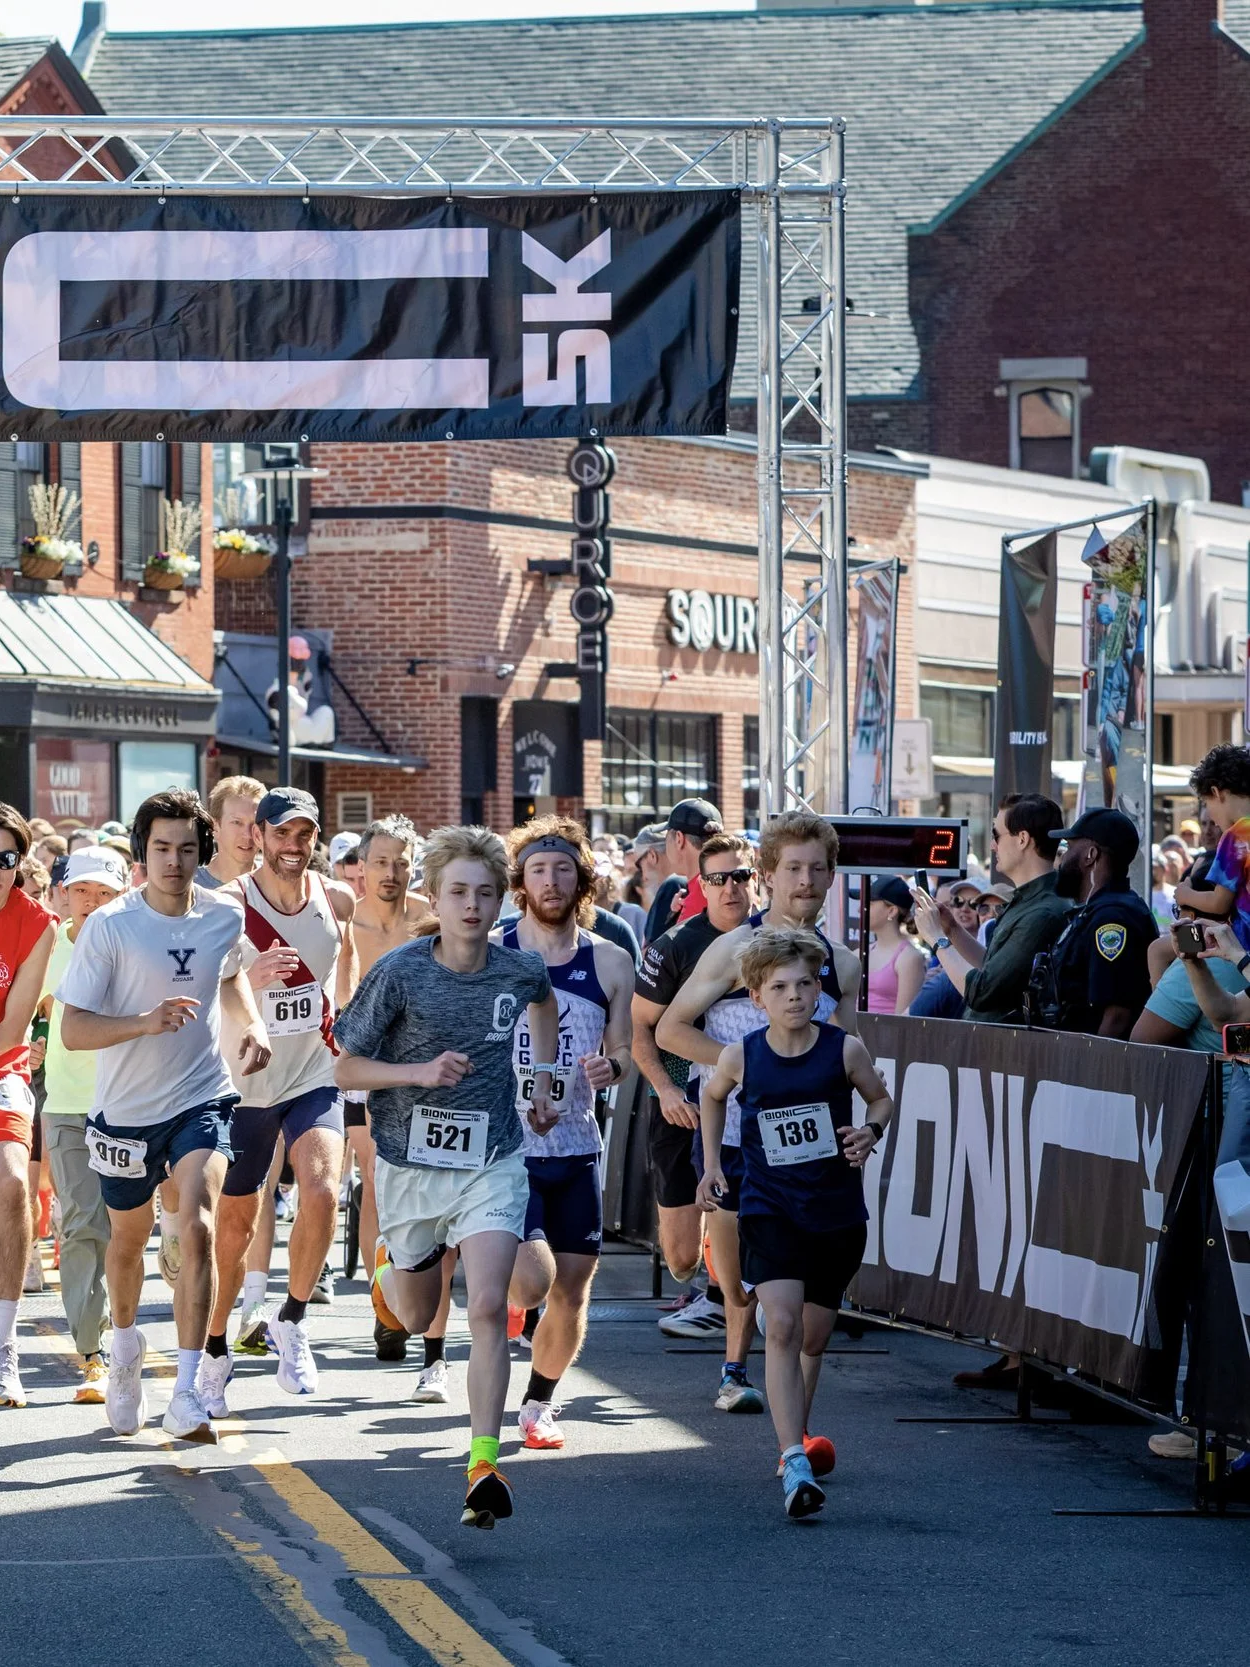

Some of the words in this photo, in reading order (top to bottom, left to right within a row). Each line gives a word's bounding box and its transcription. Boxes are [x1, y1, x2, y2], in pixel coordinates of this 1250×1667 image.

[521, 227, 612, 407] 5K
[667, 588, 759, 655] SOUR
[929, 829, 955, 866] 2
[167, 948, 197, 977] Y
[268, 986, 310, 999] BIONIC
[275, 997, 312, 1022] 619
[492, 993, 518, 1032] C
[519, 1032, 530, 1048] O
[562, 1034, 574, 1050] T
[519, 1050, 531, 1065] G
[562, 1052, 573, 1067] C
[522, 1079, 565, 1102] 69
[421, 1108, 472, 1122] BIONIC
[764, 1106, 813, 1120] BIONIC
[426, 1122, 471, 1153] 521
[774, 1117, 819, 1148] 138
[95, 1141, 132, 1168] 919
[412, 1155, 428, 1163] FOOD
[437, 1159, 454, 1167] DRINK
[852, 1057, 1140, 1340] IONIC
